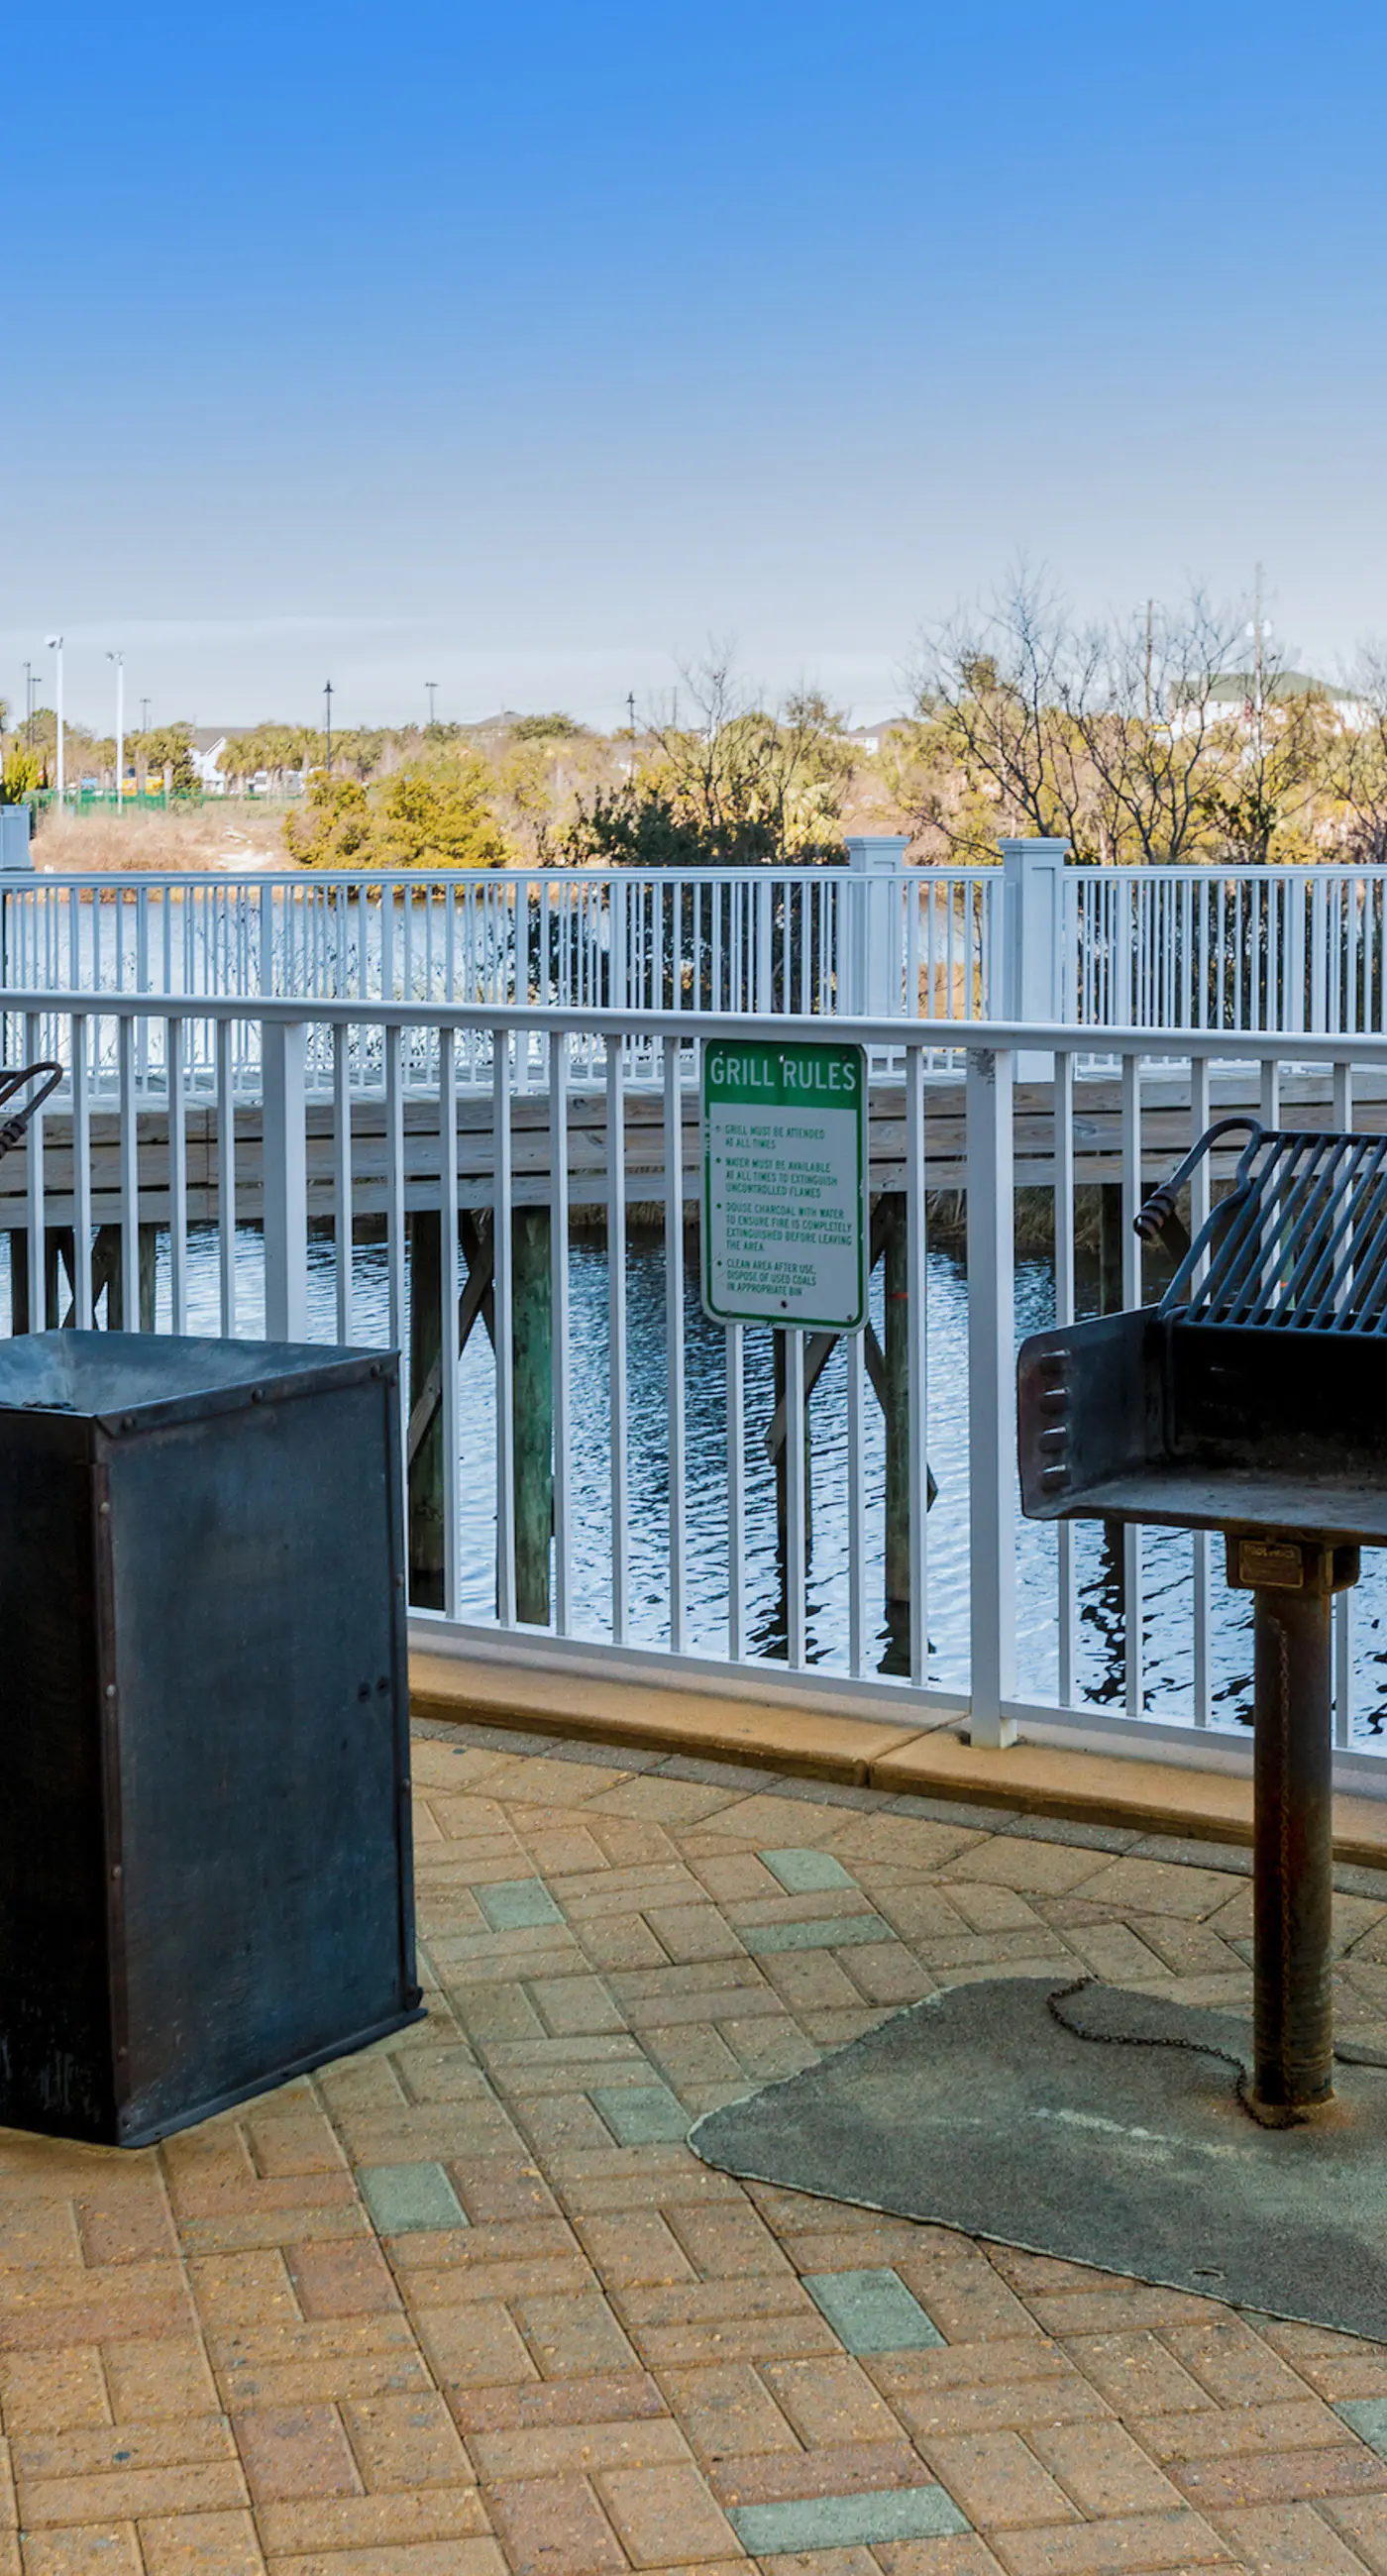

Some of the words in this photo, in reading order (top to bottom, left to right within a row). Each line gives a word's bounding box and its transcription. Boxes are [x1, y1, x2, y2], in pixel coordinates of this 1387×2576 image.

[710, 1057, 775, 1087] GRILL
[783, 1060, 856, 1091] RULES
[725, 1125, 747, 1135] GRILL
[750, 1126, 771, 1136] MUST
[774, 1127, 784, 1137] BE
[787, 1127, 825, 1139] ATTENDED
[725, 1137, 733, 1146] AT
[735, 1137, 750, 1148] ALL
[753, 1138, 776, 1149] TIMES
[725, 1157, 750, 1167] WATER
[752, 1158, 773, 1169] MUST
[776, 1159, 785, 1170] BE
[789, 1161, 831, 1173] AVAILABLE
[726, 1170, 734, 1179] AT
[736, 1170, 751, 1181] ALL
[753, 1171, 776, 1182] TIMES
[779, 1173, 788, 1183] TO
[791, 1173, 838, 1186] EXTINGUISH
[725, 1183, 787, 1195] UNCONTROLLED
[790, 1186, 820, 1198] FLAMES
[726, 1202, 752, 1214] DOUSE
[754, 1204, 795, 1216] CHARCOAL
[799, 1207, 816, 1217] WITH
[819, 1208, 844, 1219] WATER
[726, 1215, 736, 1225] TO
[738, 1216, 769, 1228] ENSURE
[772, 1217, 790, 1229] FIRE
[792, 1219, 800, 1229] IS
[802, 1220, 852, 1233] COMPLETELY
[726, 1228, 783, 1240] EXTINGUISHED
[785, 1231, 816, 1242] BEFORE
[818, 1234, 852, 1245] LEAVING
[726, 1239, 740, 1249] THE
[743, 1241, 764, 1251] AREA
[727, 1258, 750, 1269] CLEAN
[752, 1259, 771, 1270] AREA
[774, 1261, 797, 1273] AFTER
[726, 1270, 757, 1282] DISPOSE
[760, 1272, 769, 1282] OF
[771, 1273, 790, 1284] USED
[793, 1275, 816, 1286] COALS
[727, 1282, 735, 1292] IN
[736, 1283, 787, 1296] APPROPRIATE
[789, 1287, 802, 1296] BIN
